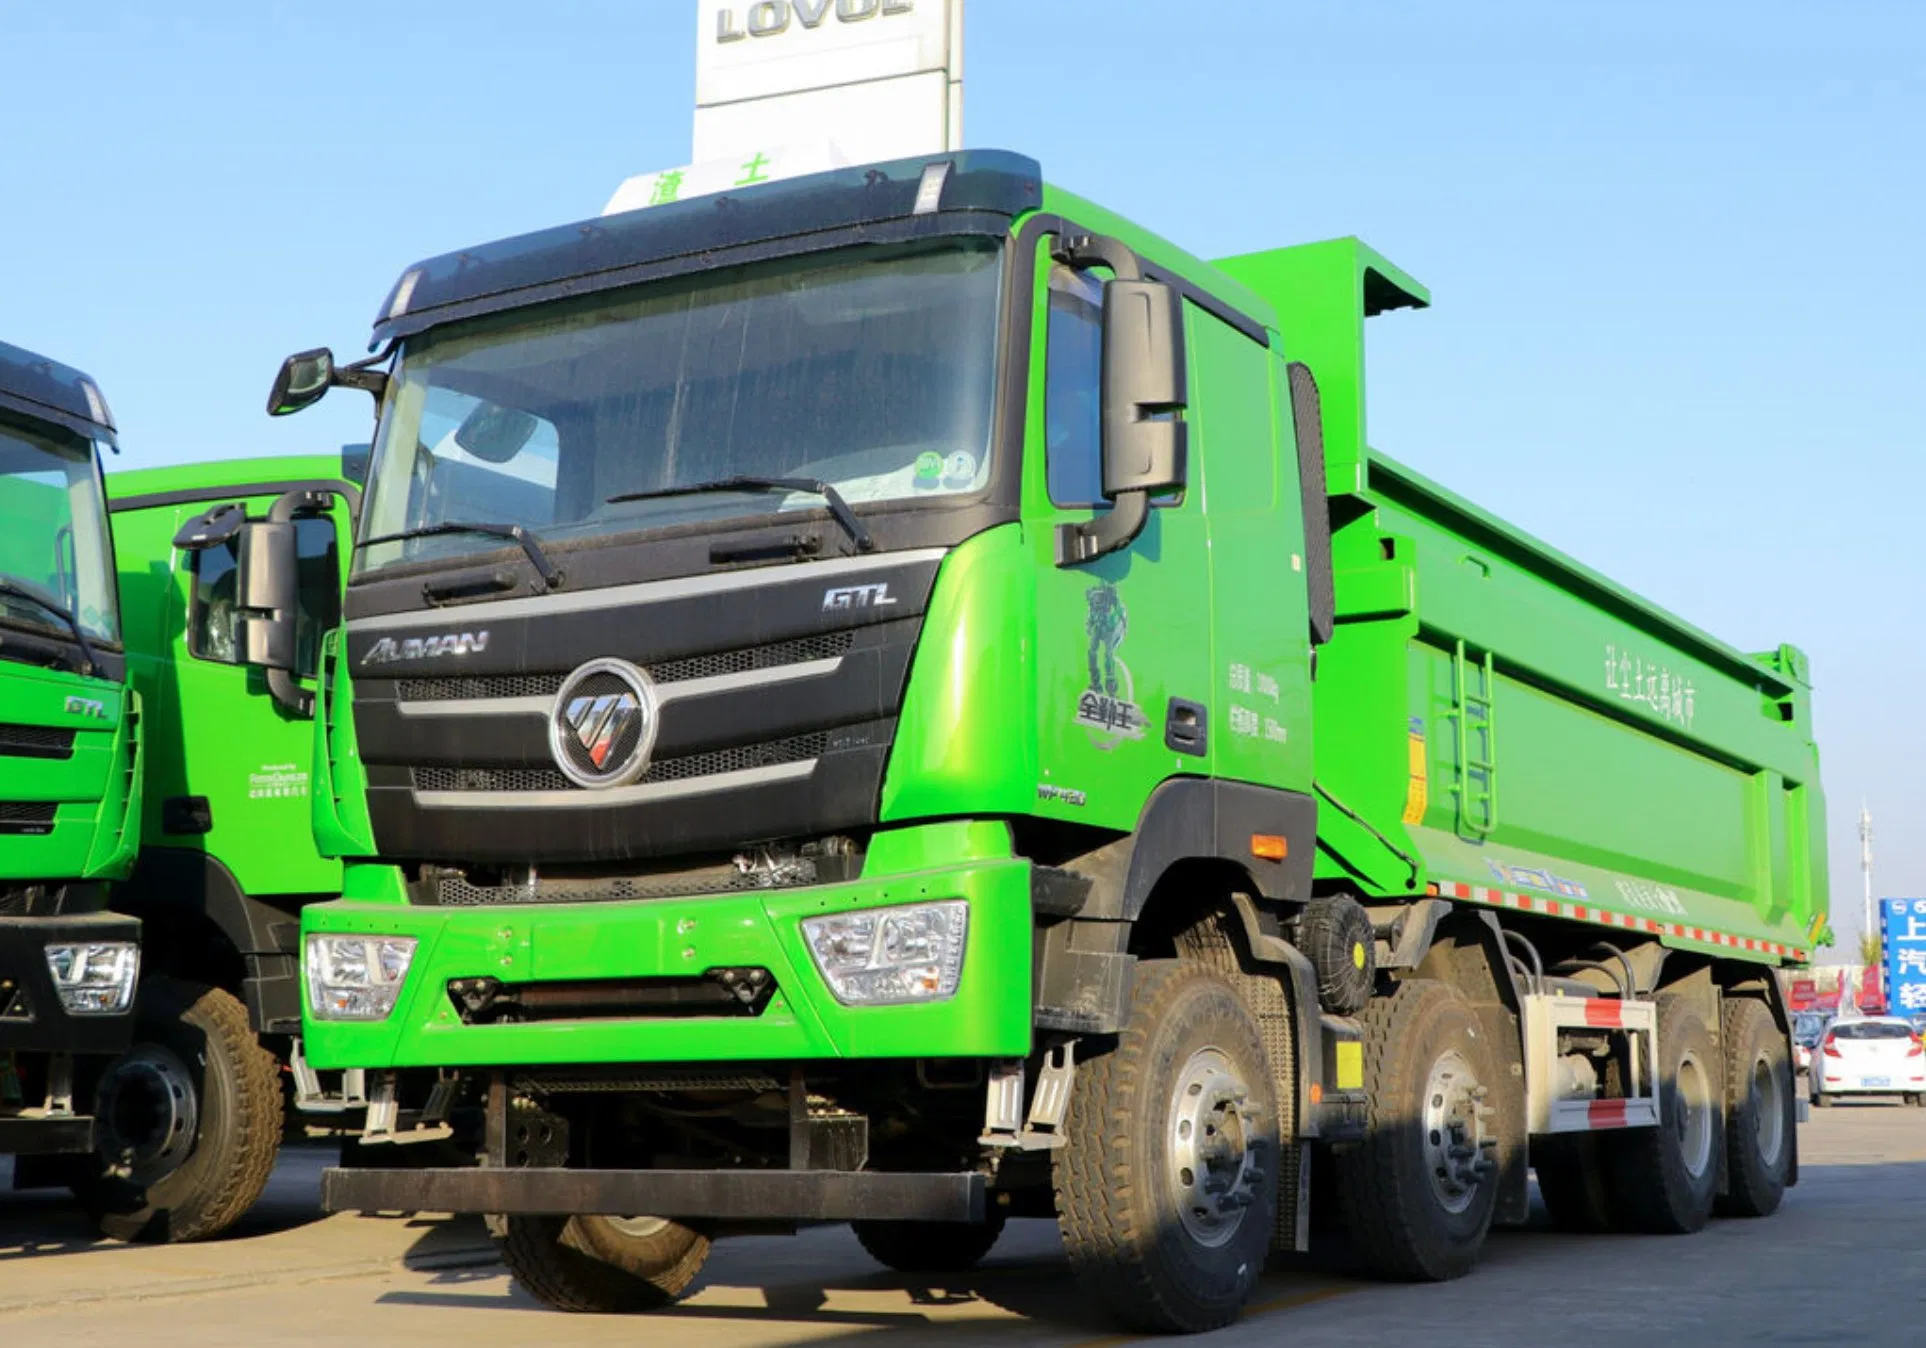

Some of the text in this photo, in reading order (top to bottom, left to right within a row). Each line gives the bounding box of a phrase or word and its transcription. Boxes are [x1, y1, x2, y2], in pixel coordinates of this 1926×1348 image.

[823, 582, 898, 611] GTL
[360, 630, 490, 665] AUMAN
[1604, 643, 1696, 731] 让尘土远离城市
[64, 695, 109, 719] GTL
